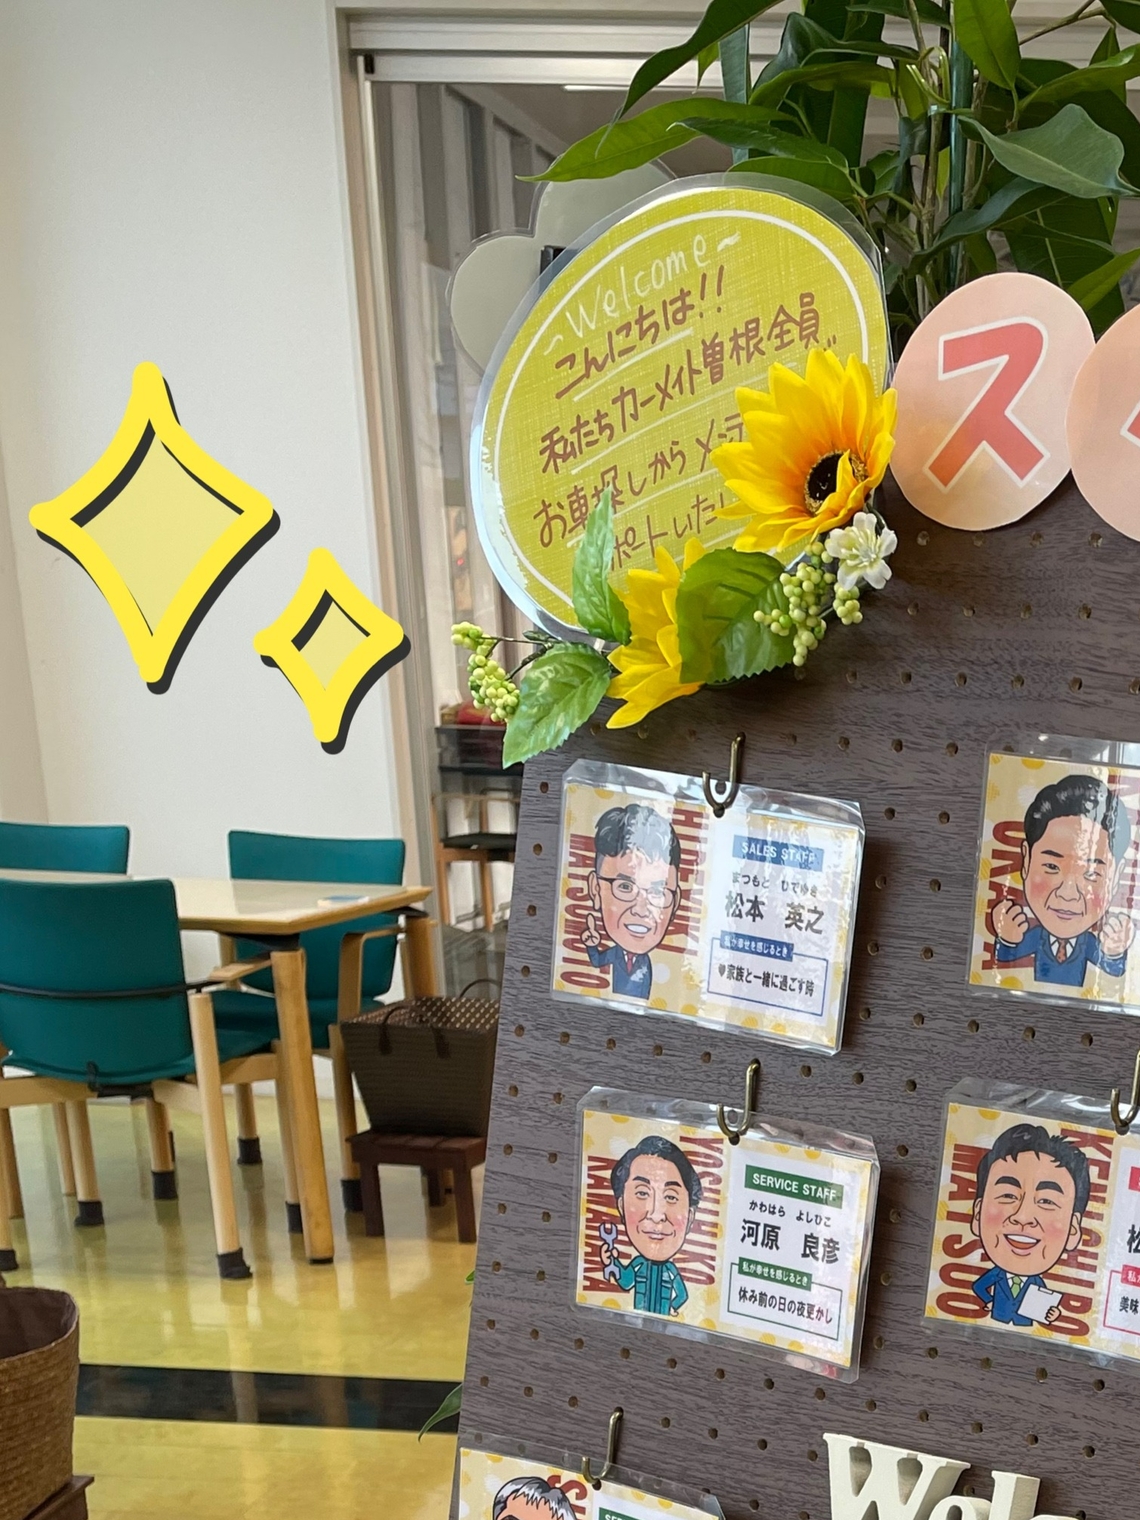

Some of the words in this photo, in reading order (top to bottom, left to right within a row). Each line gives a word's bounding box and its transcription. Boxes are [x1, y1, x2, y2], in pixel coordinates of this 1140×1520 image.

[741, 842, 777, 859] SALES
[780, 848, 816, 864] STAFF
[732, 873, 769, 889] まつもと
[781, 879, 818, 898] ひでゆき
[725, 891, 765, 923] 松本
[784, 902, 826, 934] 英之
[752, 1173, 798, 1192] SERVICE
[802, 1184, 836, 1201] STAFF
[749, 1200, 786, 1217] かわはら
[796, 1209, 832, 1228] よしひこ
[740, 1219, 781, 1250] 河原
[800, 1232, 840, 1265] 良彦
[742, 1261, 808, 1286] 私が幸せを感じるとき
[738, 1286, 833, 1325] 休み前の日の夜更かし
